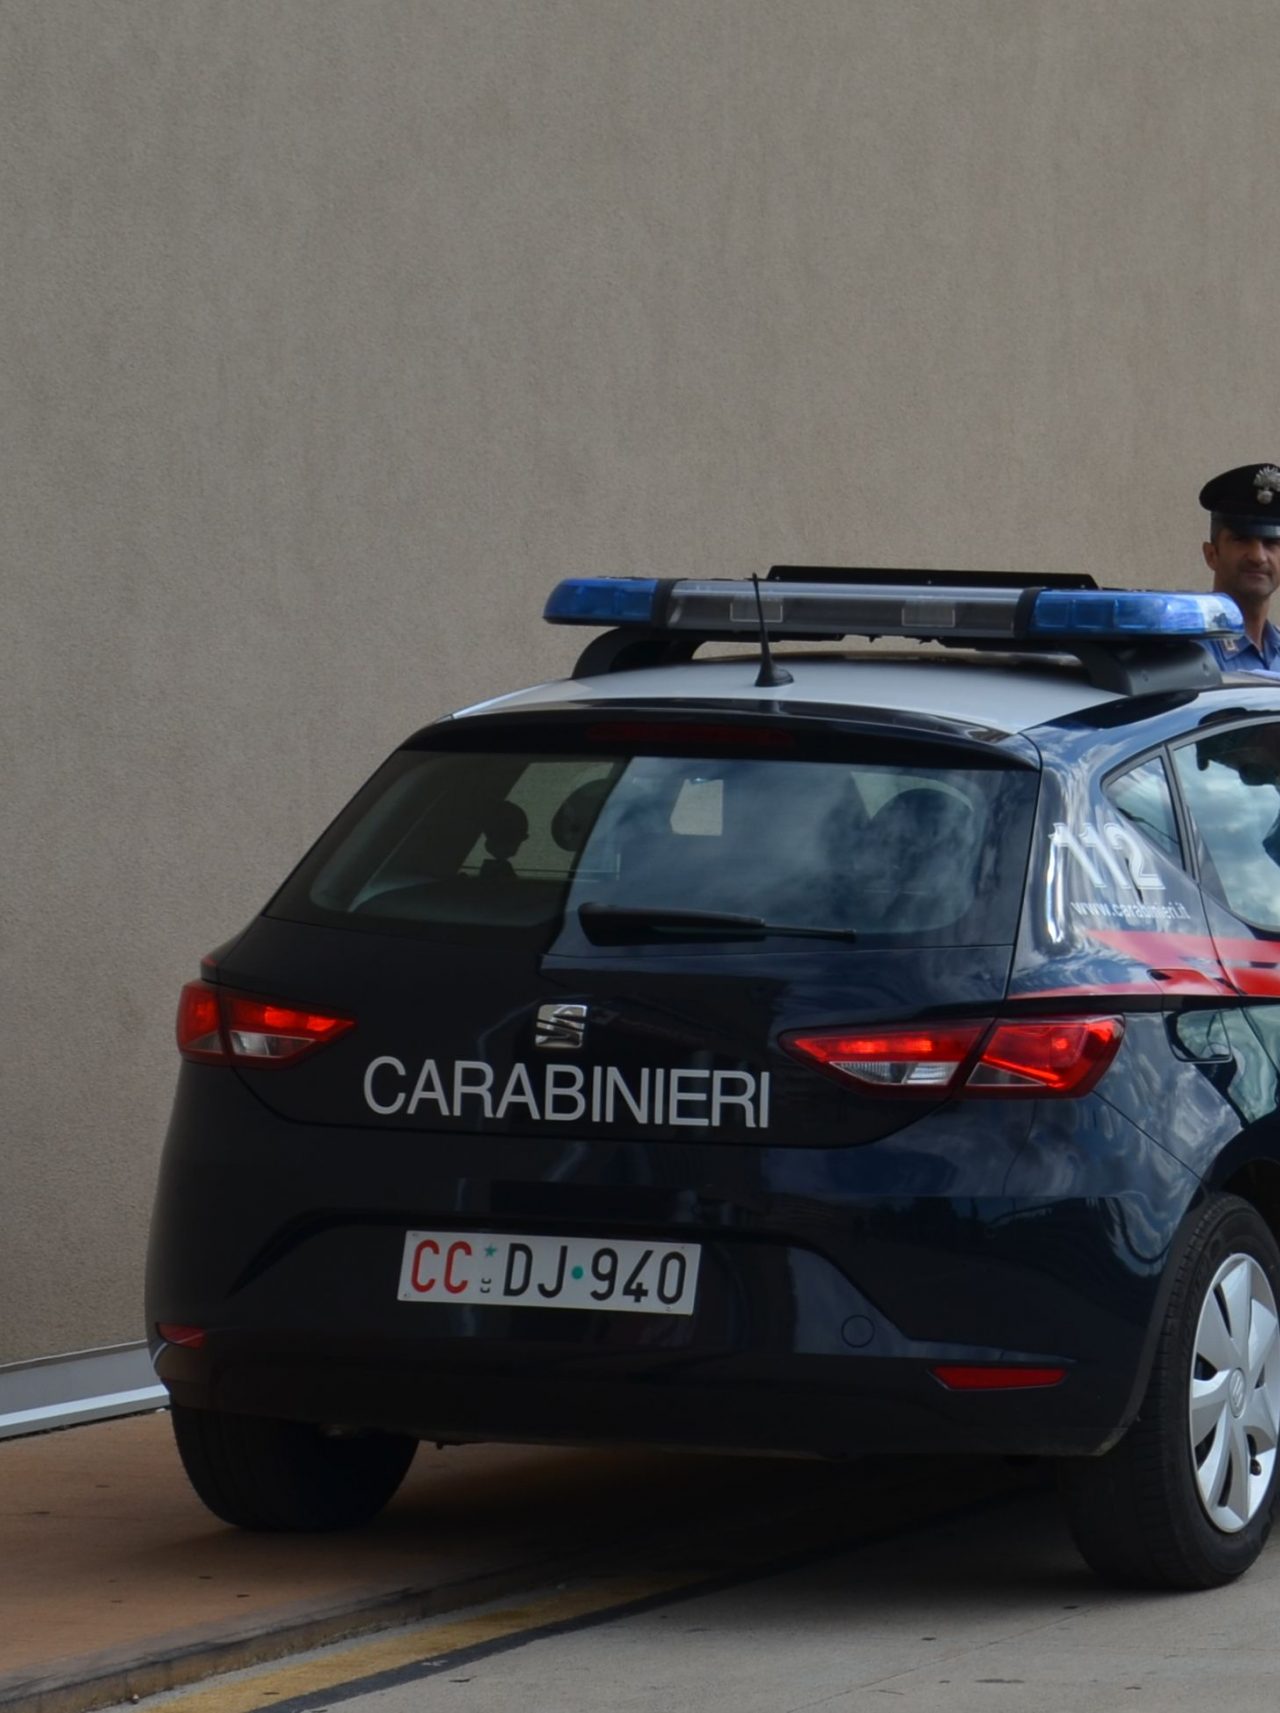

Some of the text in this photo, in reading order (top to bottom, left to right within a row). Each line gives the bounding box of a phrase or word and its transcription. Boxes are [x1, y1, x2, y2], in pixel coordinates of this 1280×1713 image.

[1048, 822, 1166, 889] 112
[363, 1055, 771, 1128] CARABINIERI
[411, 1240, 472, 1294] CC
